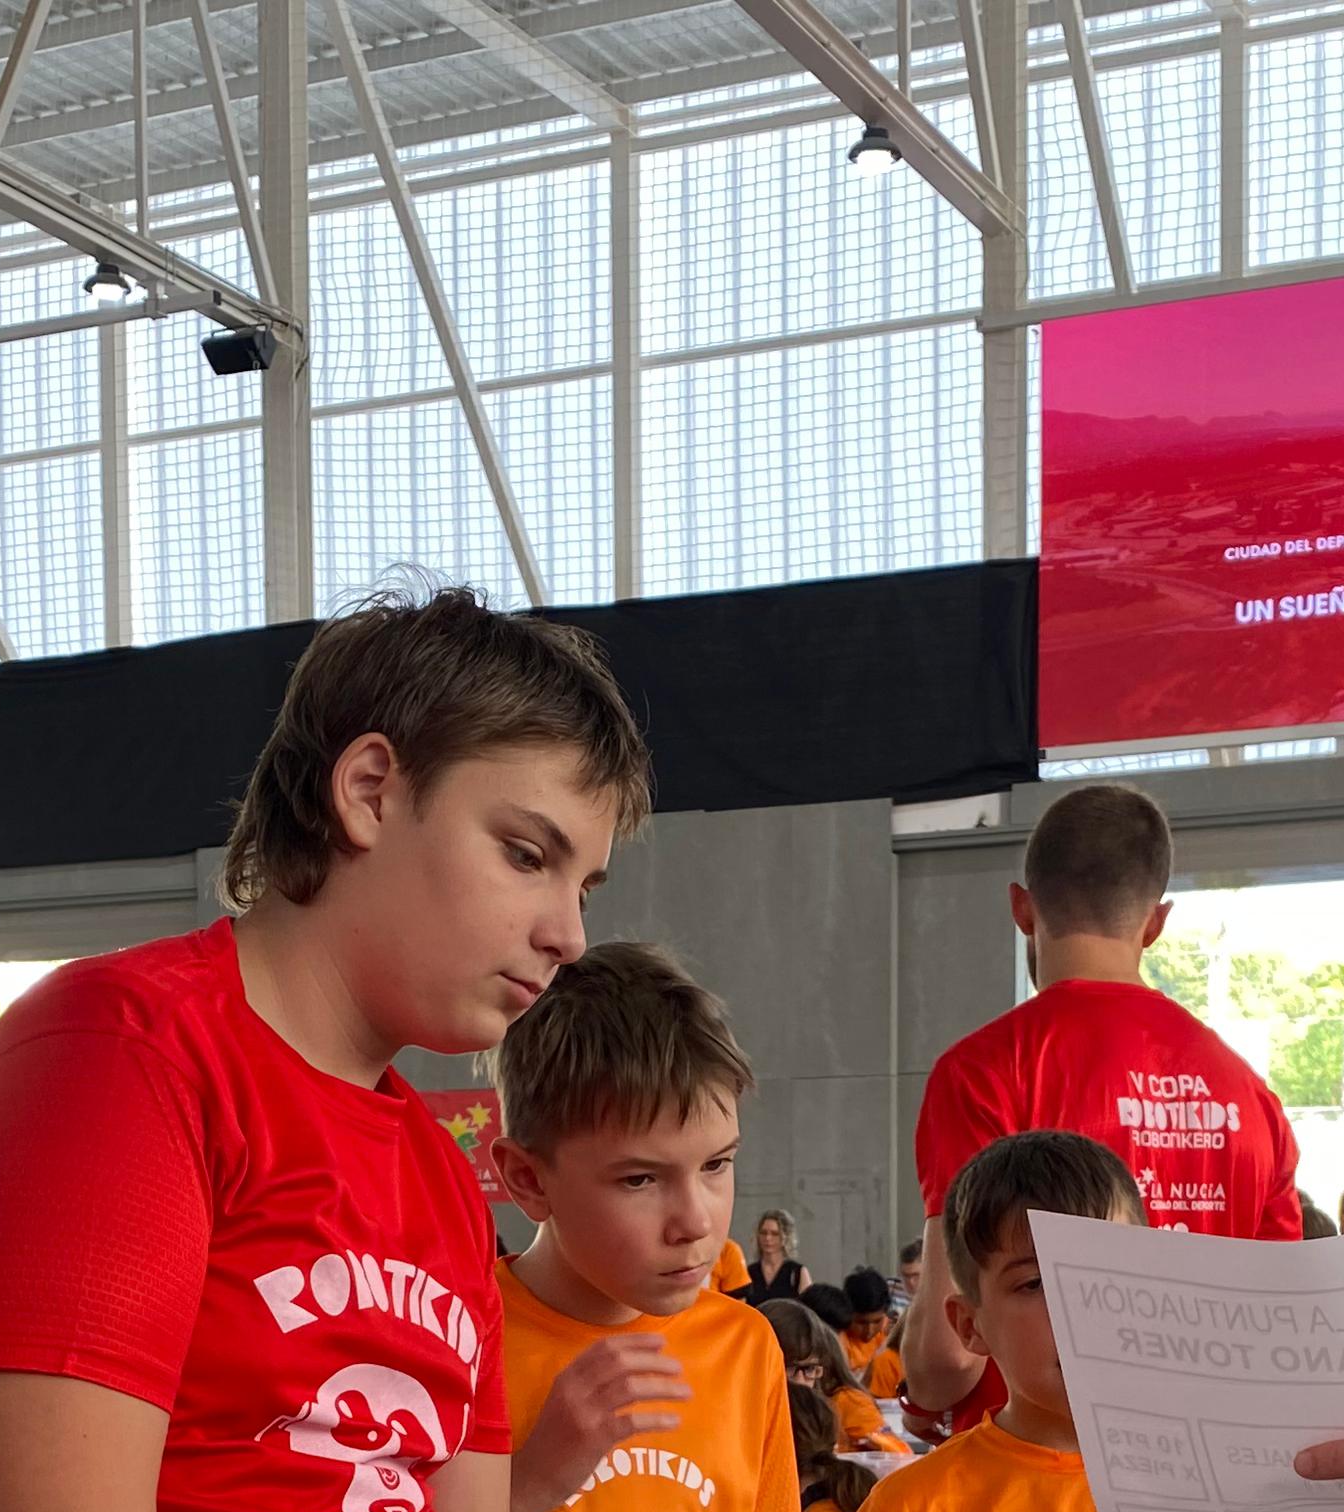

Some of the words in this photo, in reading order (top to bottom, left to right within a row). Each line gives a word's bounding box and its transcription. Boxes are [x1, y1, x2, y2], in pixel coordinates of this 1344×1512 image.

[1223, 543, 1282, 562] CIUDAD
[1285, 539, 1313, 555] DEL
[1235, 599, 1276, 625] UN
[1129, 1070, 1144, 1094] V
[1148, 1074, 1211, 1099] COPA
[1151, 1182, 1164, 1199] LA
[1170, 1182, 1226, 1199] NUCÍA
[564, 1447, 716, 1508] BOTIKIDS
